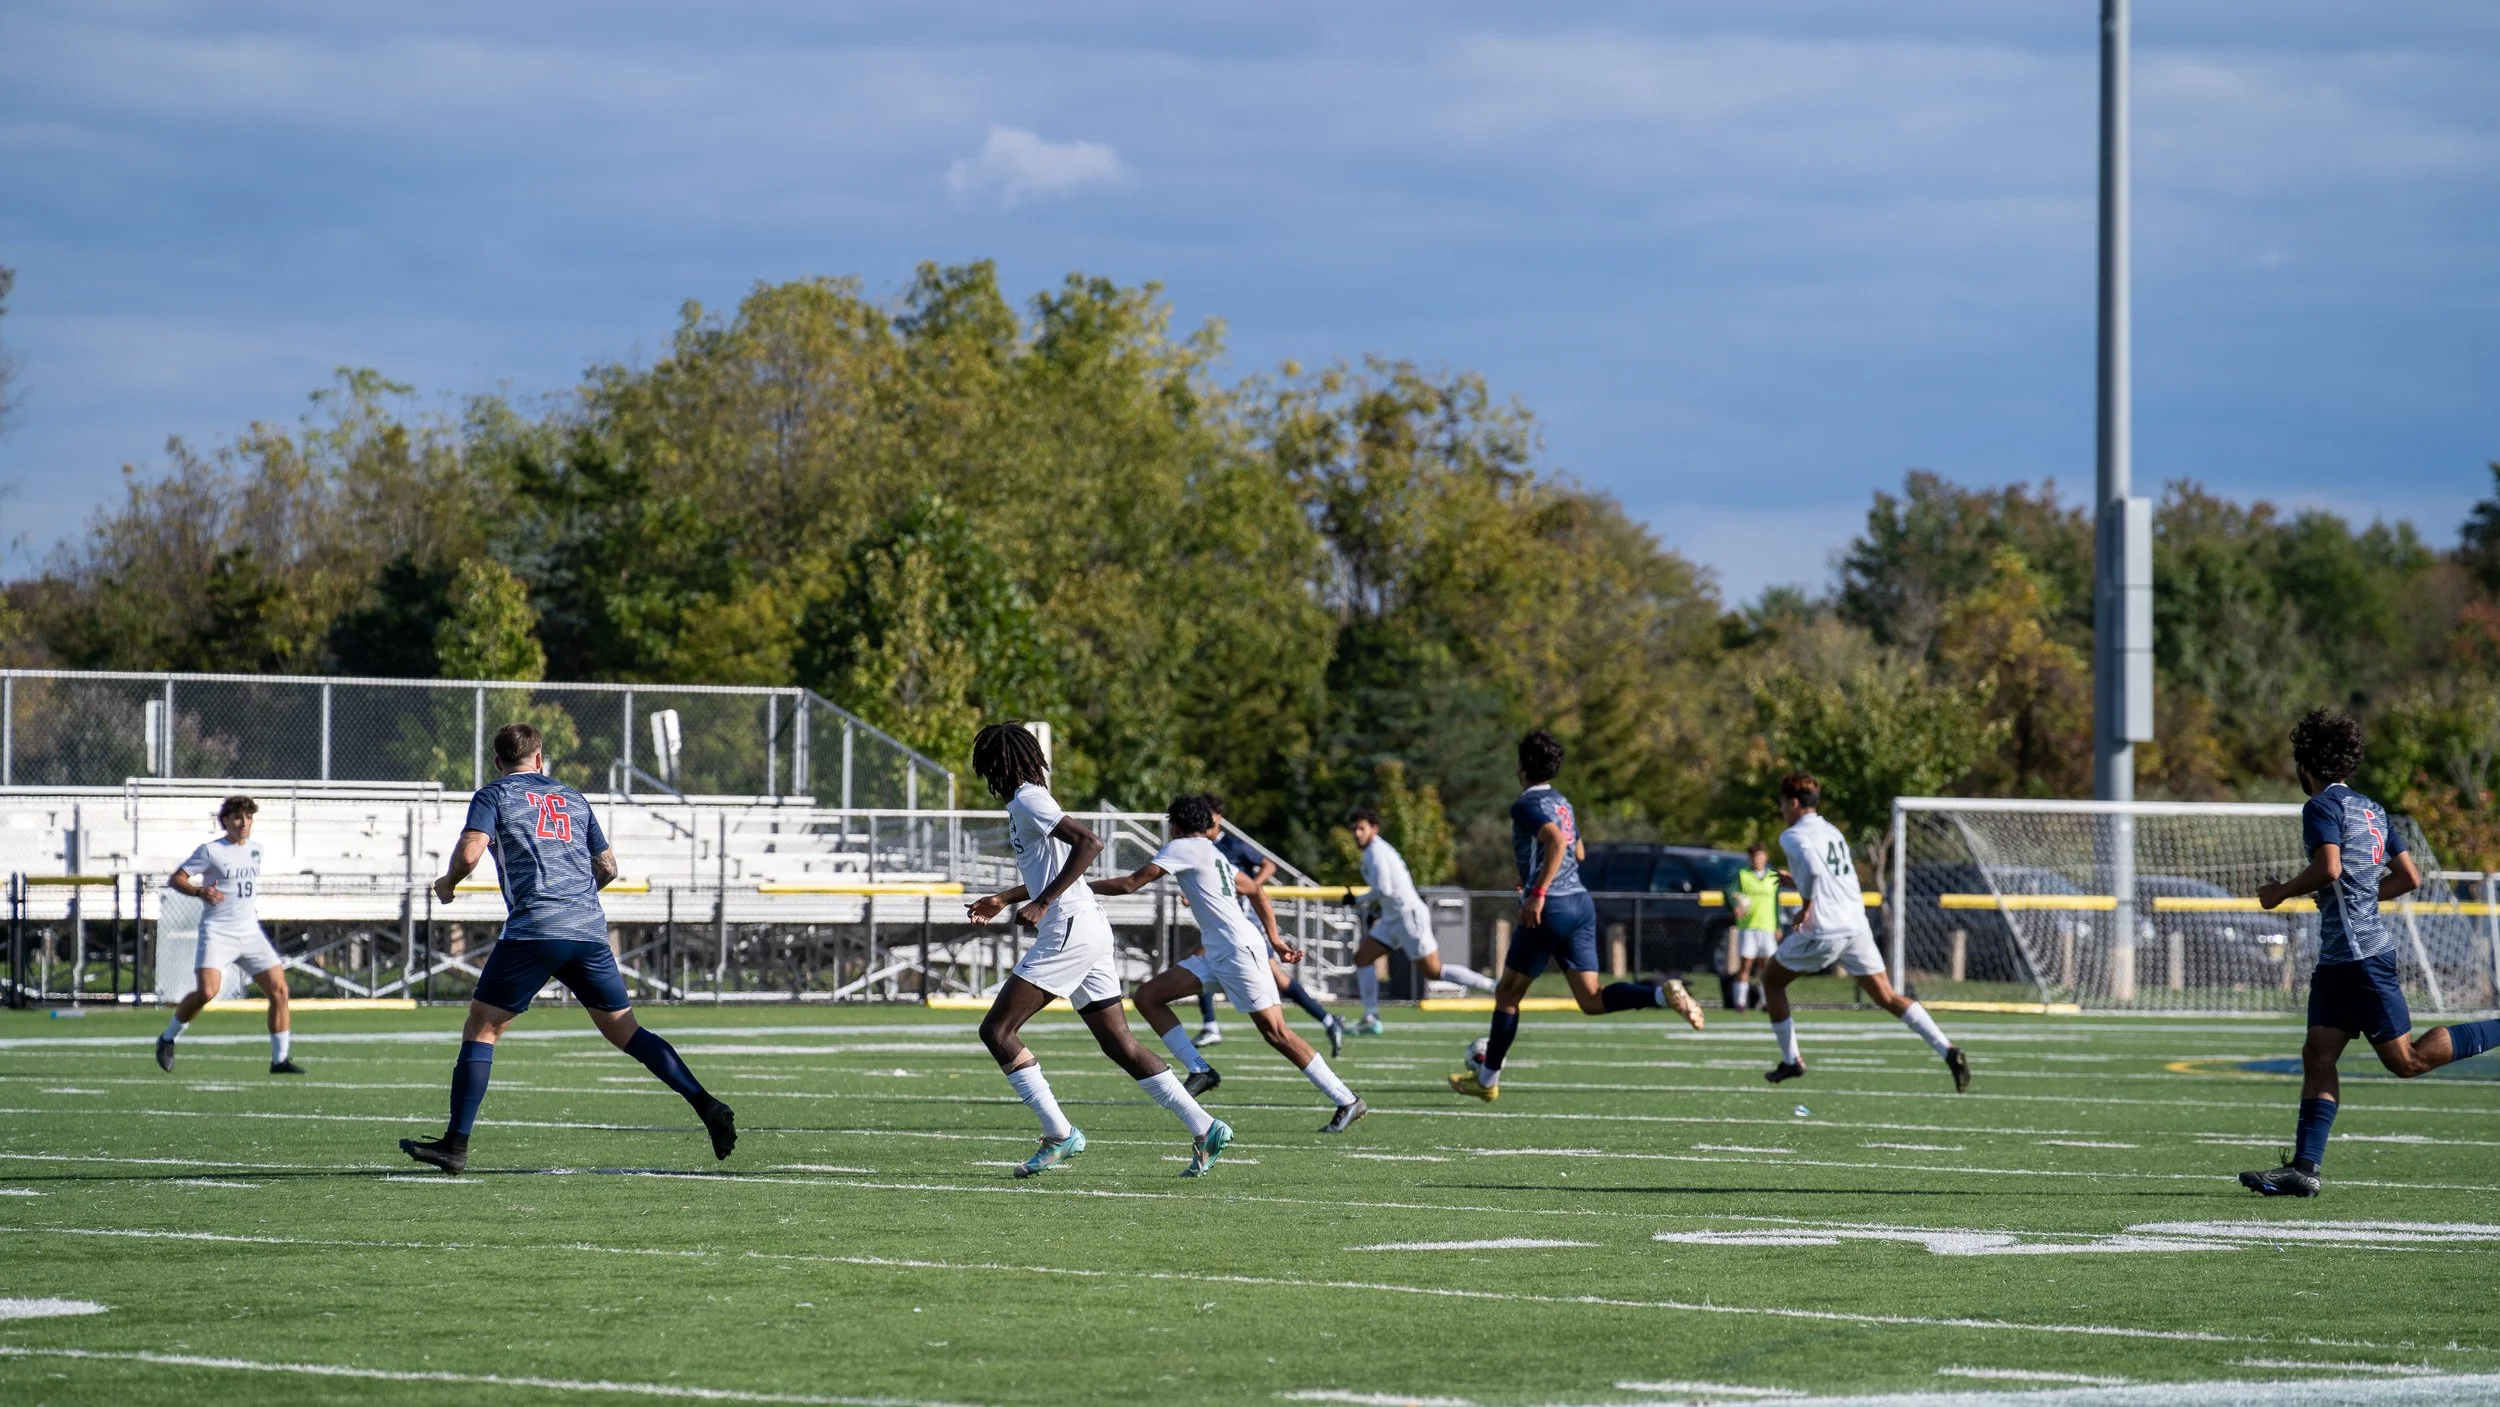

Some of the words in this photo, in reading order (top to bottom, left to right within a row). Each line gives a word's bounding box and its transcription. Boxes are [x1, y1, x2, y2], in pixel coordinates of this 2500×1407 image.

[525, 791, 572, 843] 26
[2363, 808, 2385, 865] 5
[236, 881, 253, 898] 19
